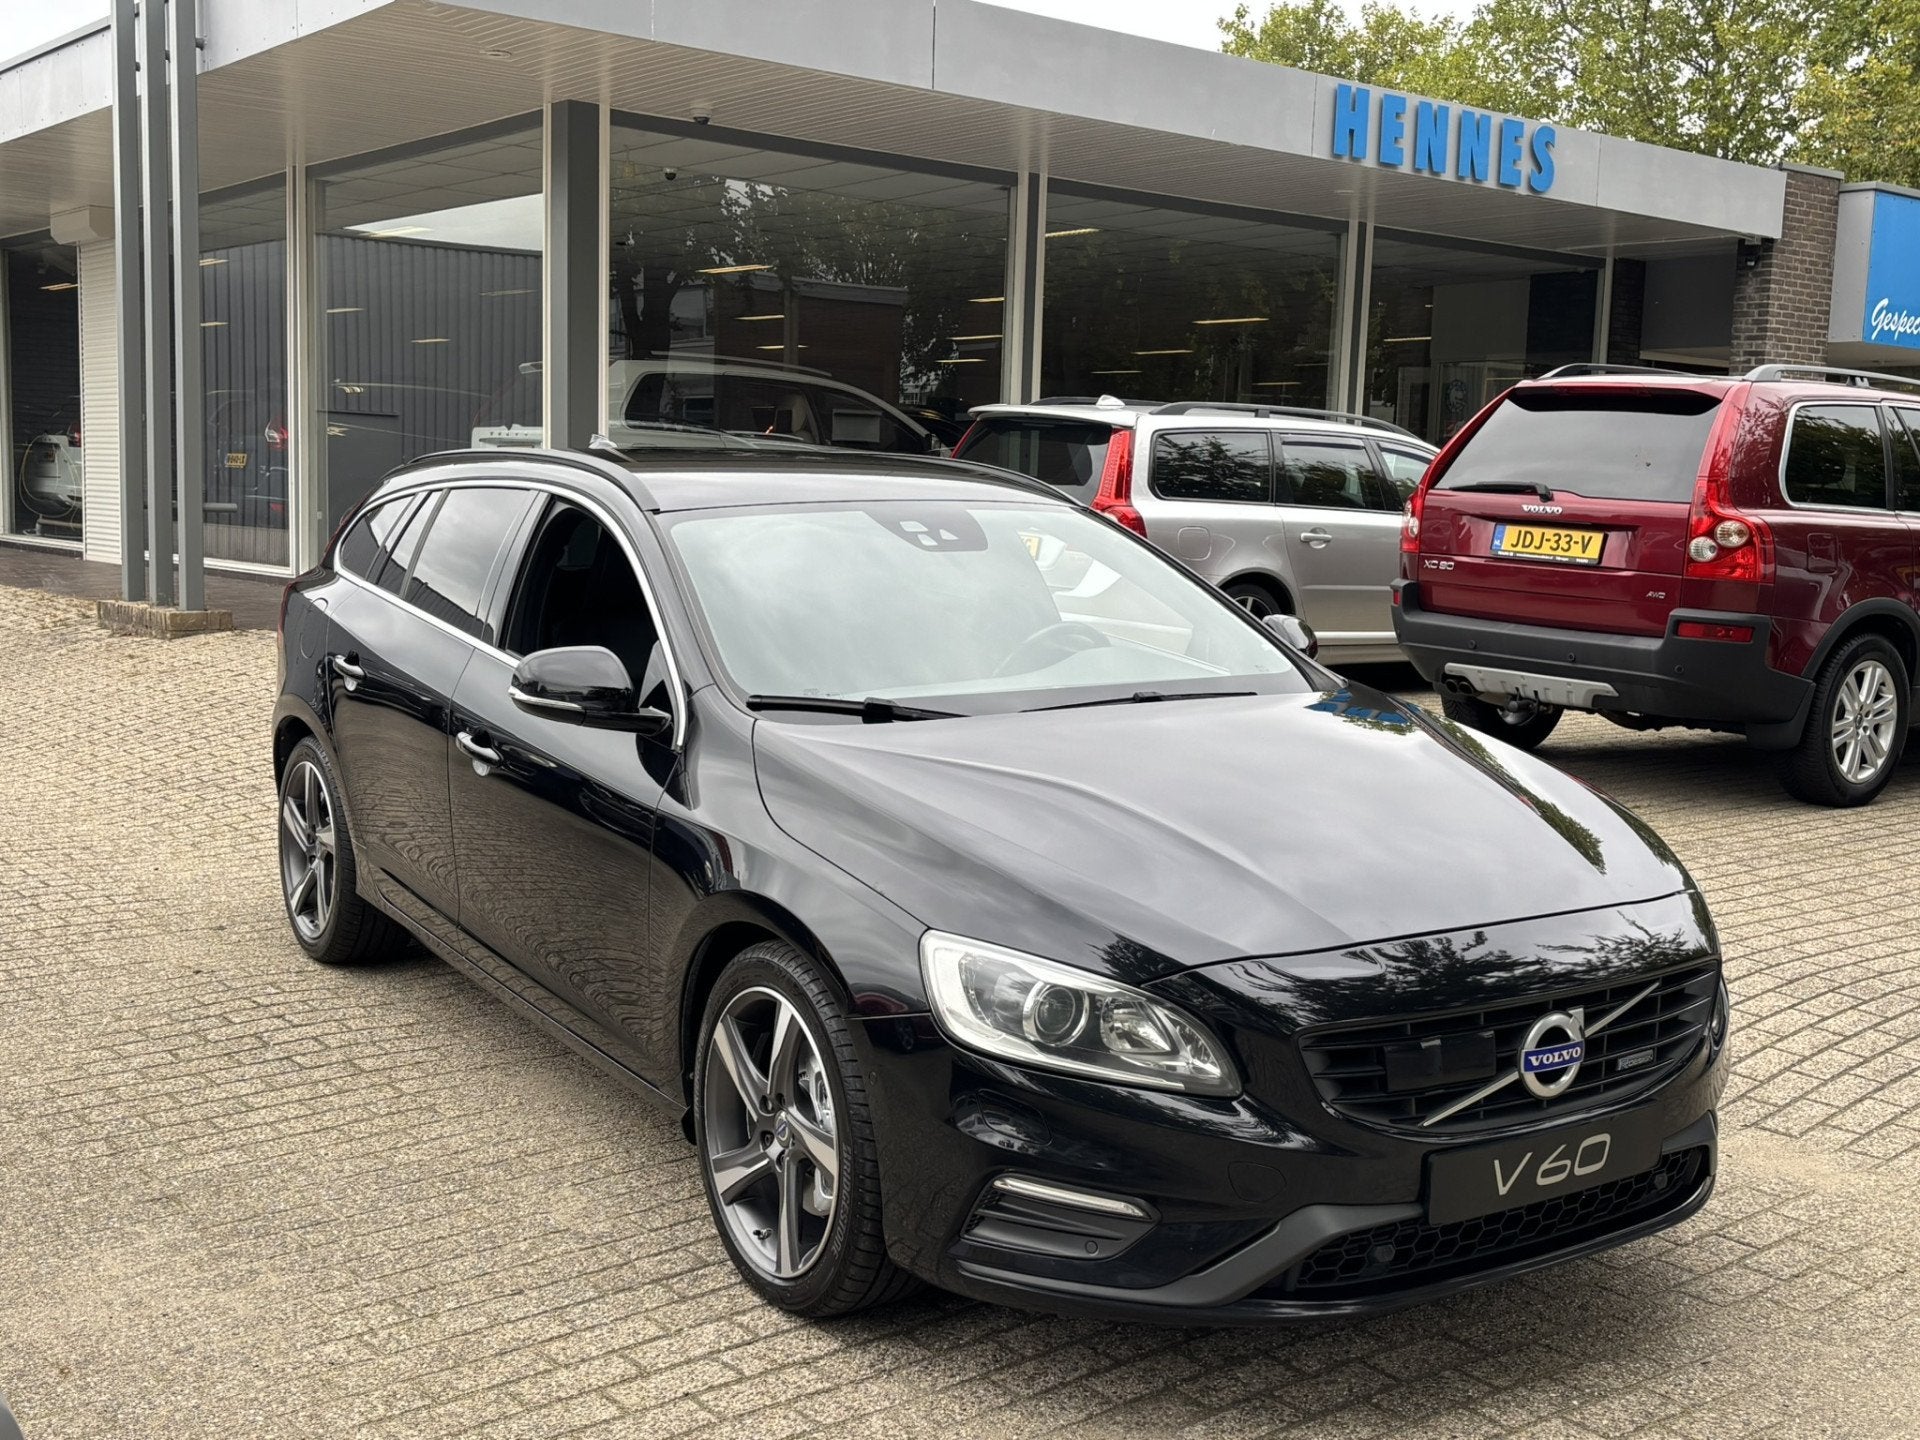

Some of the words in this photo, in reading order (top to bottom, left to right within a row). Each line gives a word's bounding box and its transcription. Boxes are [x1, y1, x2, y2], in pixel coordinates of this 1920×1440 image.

[1333, 82, 1556, 194] HENNES
[1521, 504, 1563, 514] VOLVO
[1510, 529, 1593, 554] JDJ-33-V
[1529, 1046, 1581, 1066] VOLVO
[832, 1142, 852, 1260] BRIDGESTONE
